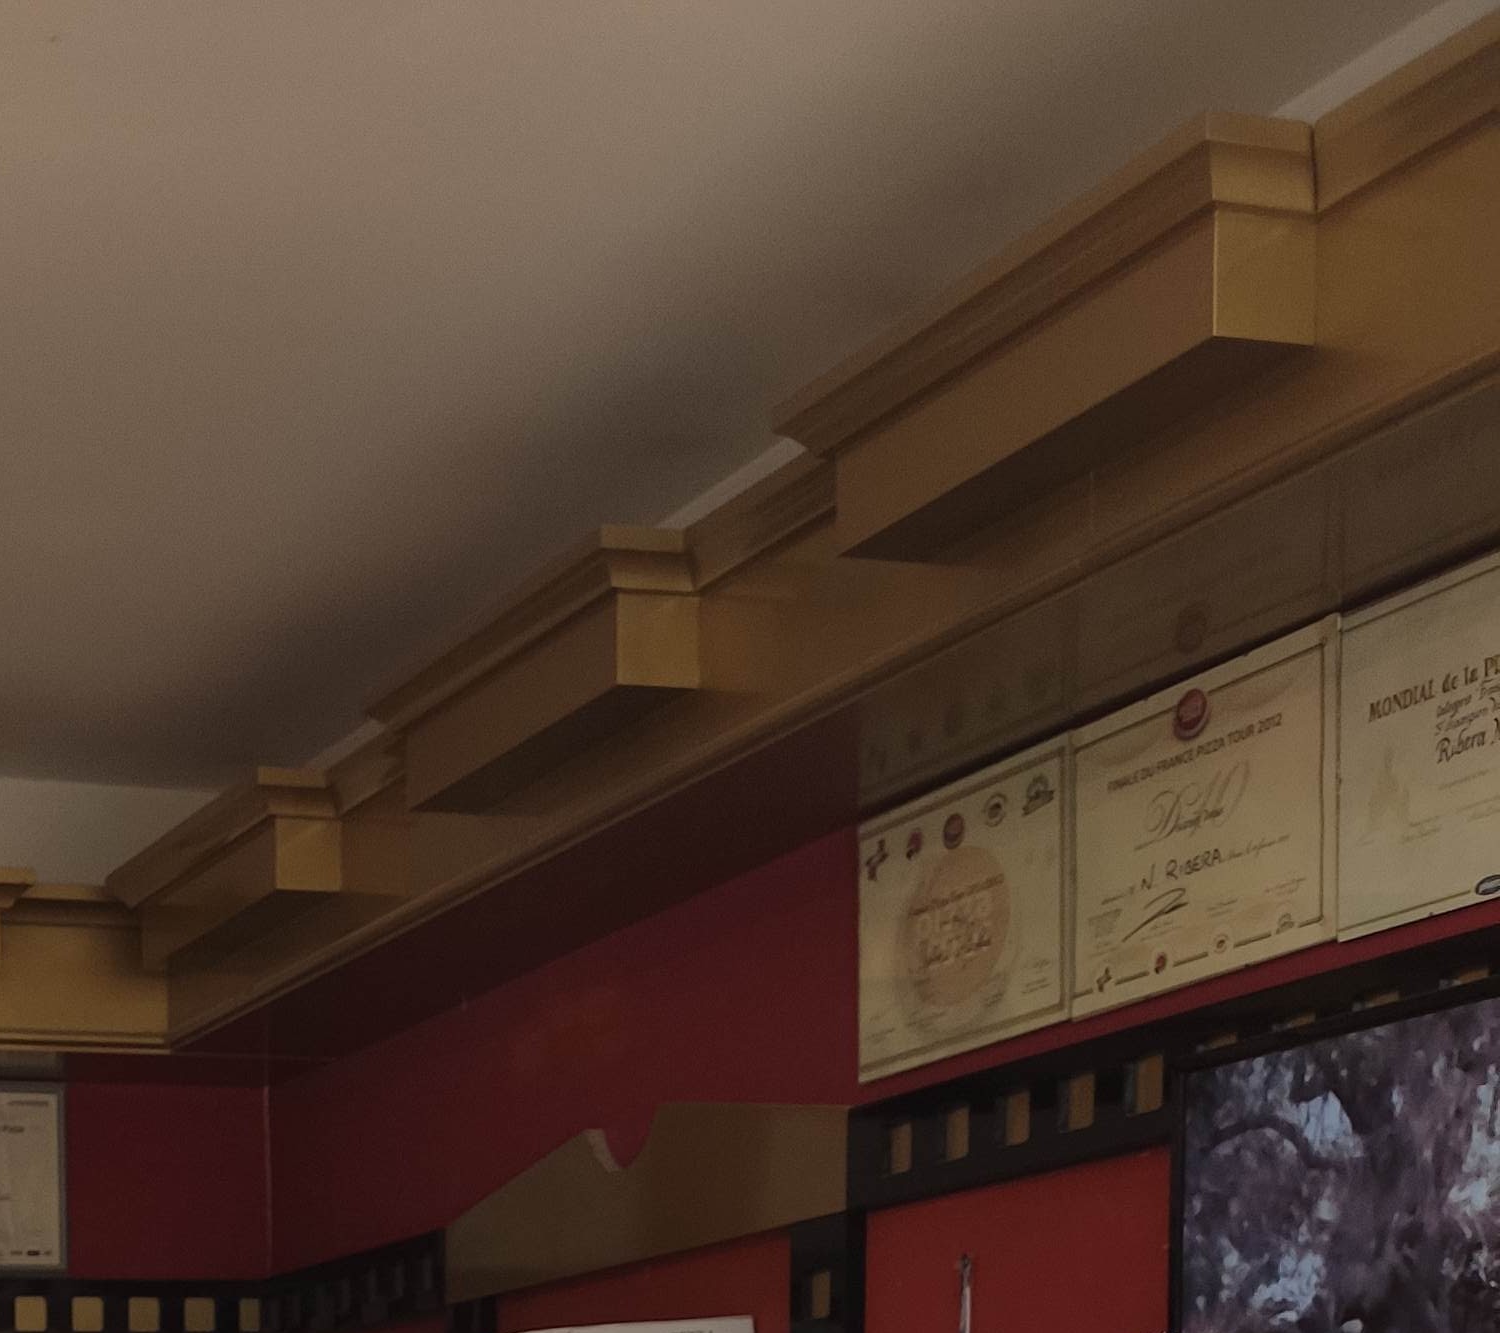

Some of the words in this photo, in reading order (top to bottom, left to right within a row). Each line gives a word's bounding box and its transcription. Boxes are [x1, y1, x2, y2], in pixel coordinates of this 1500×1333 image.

[1369, 678, 1436, 722] MONDIAL
[1442, 672, 1458, 693] de
[1464, 667, 1478, 685] la
[1155, 748, 1194, 774] FRANCE
[1195, 735, 1225, 759] PIZZA
[1227, 723, 1254, 746] TOUR
[1256, 711, 1283, 735] 2012
[1436, 728, 1486, 764] Ribera
